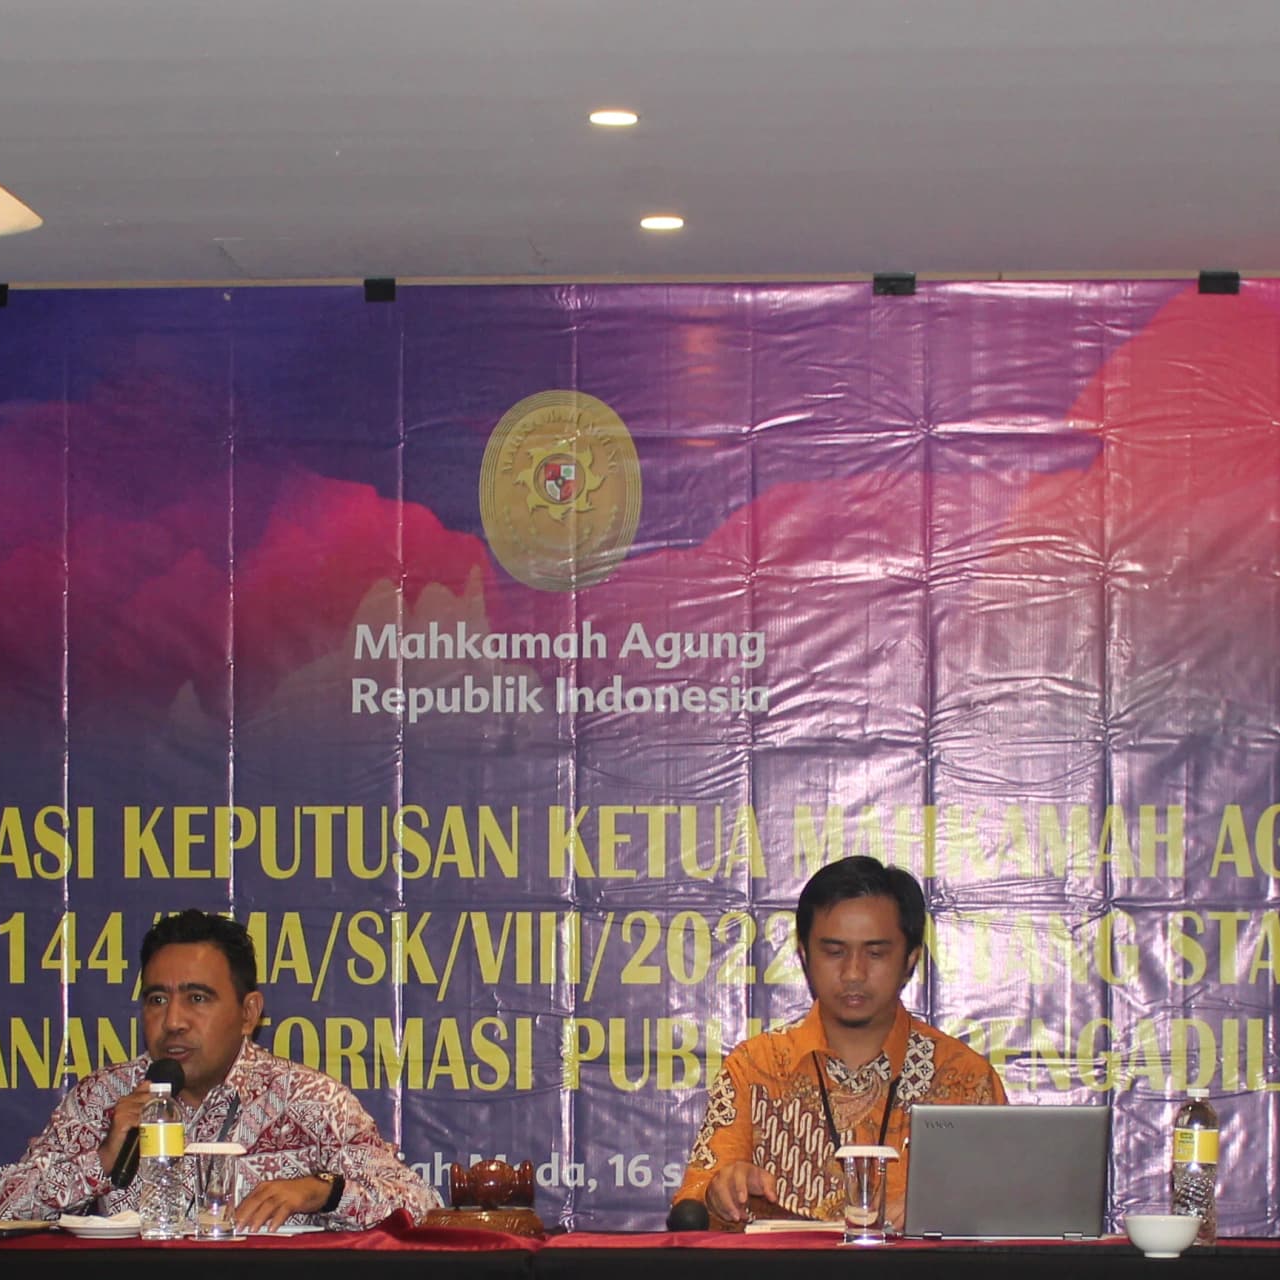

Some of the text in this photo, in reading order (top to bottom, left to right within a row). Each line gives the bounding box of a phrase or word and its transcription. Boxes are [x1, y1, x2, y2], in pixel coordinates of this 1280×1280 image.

[353, 622, 766, 669] Mahkamah Agung
[351, 676, 769, 722] Republik Indonesia
[124, 804, 519, 880] KEPUTUSAN
[548, 804, 766, 880] KETUA
[793, 804, 1185, 878] MAHKAMAH
[916, 911, 1140, 985] NTANG
[261, 1016, 533, 1091] ORMASI
[563, 1016, 806, 1091] PUBL
[608, 1153, 653, 1188] 16
